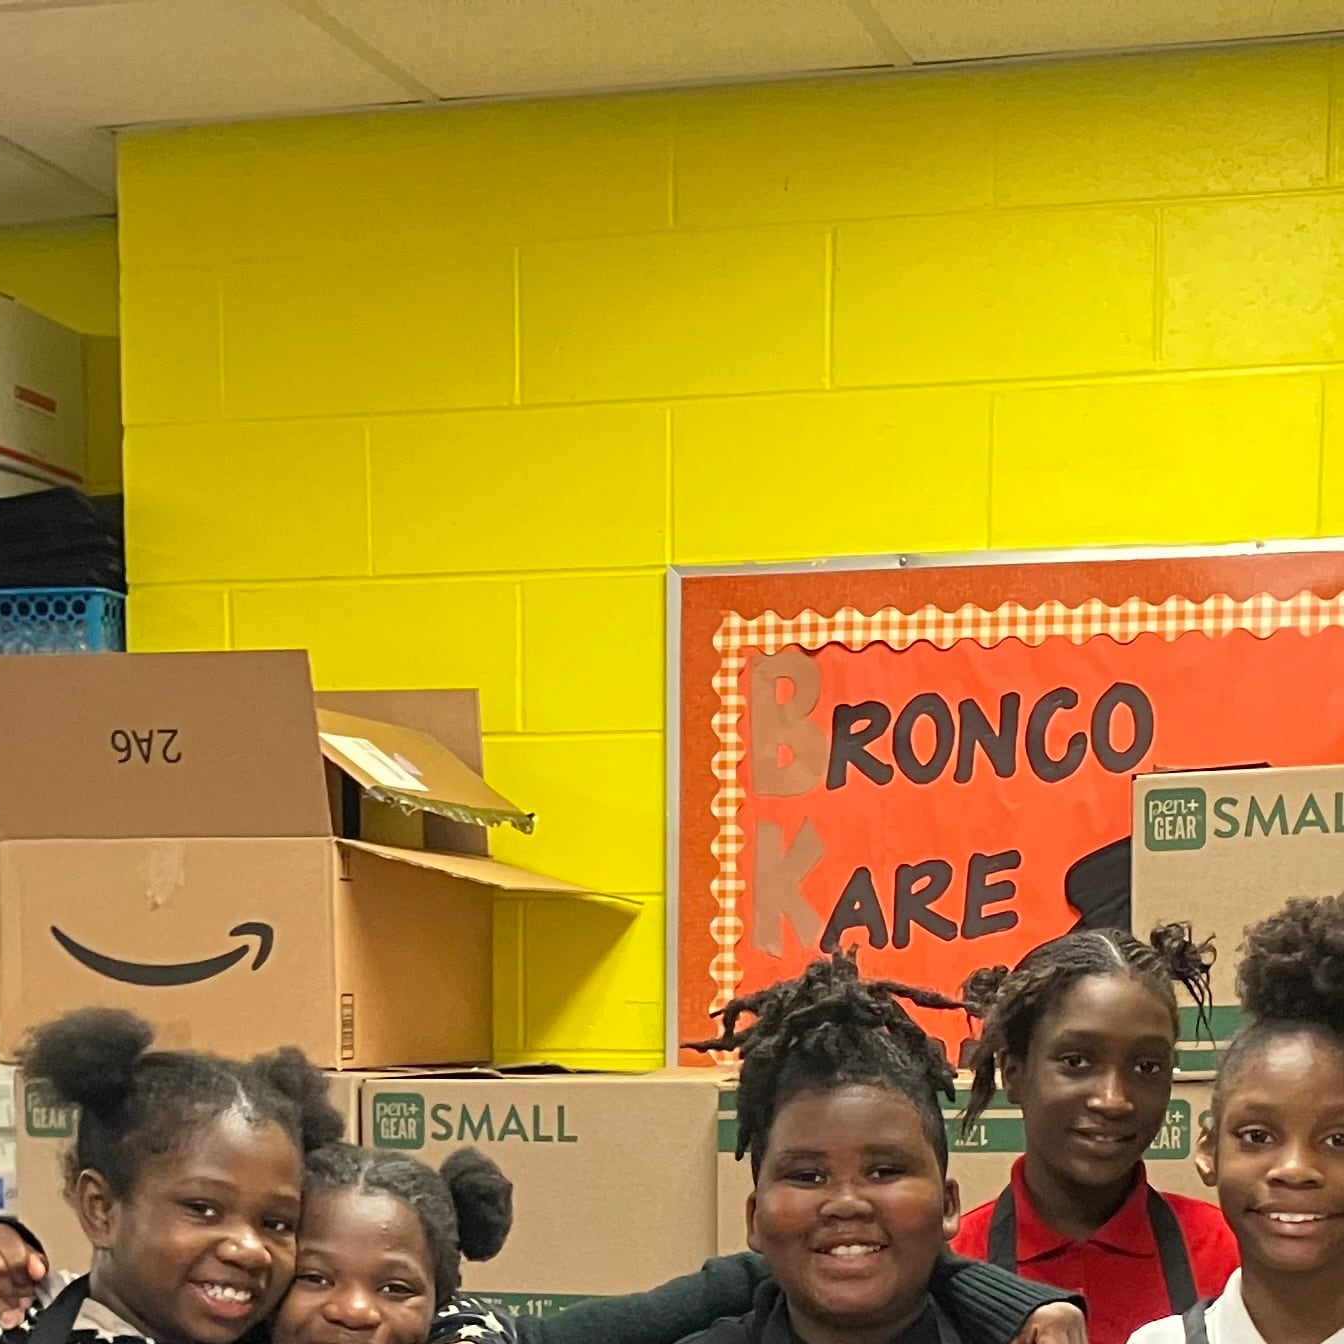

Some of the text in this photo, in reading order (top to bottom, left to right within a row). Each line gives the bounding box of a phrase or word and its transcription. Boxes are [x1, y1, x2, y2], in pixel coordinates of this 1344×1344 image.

[750, 653, 1154, 792] BRONCO
[111, 729, 182, 763] 2A6
[1148, 799, 1199, 823] pen+
[1154, 815, 1197, 841] GEAR
[751, 817, 1022, 960] KARE
[380, 1117, 417, 1140] GEAR
[430, 1103, 578, 1142] SMALL
